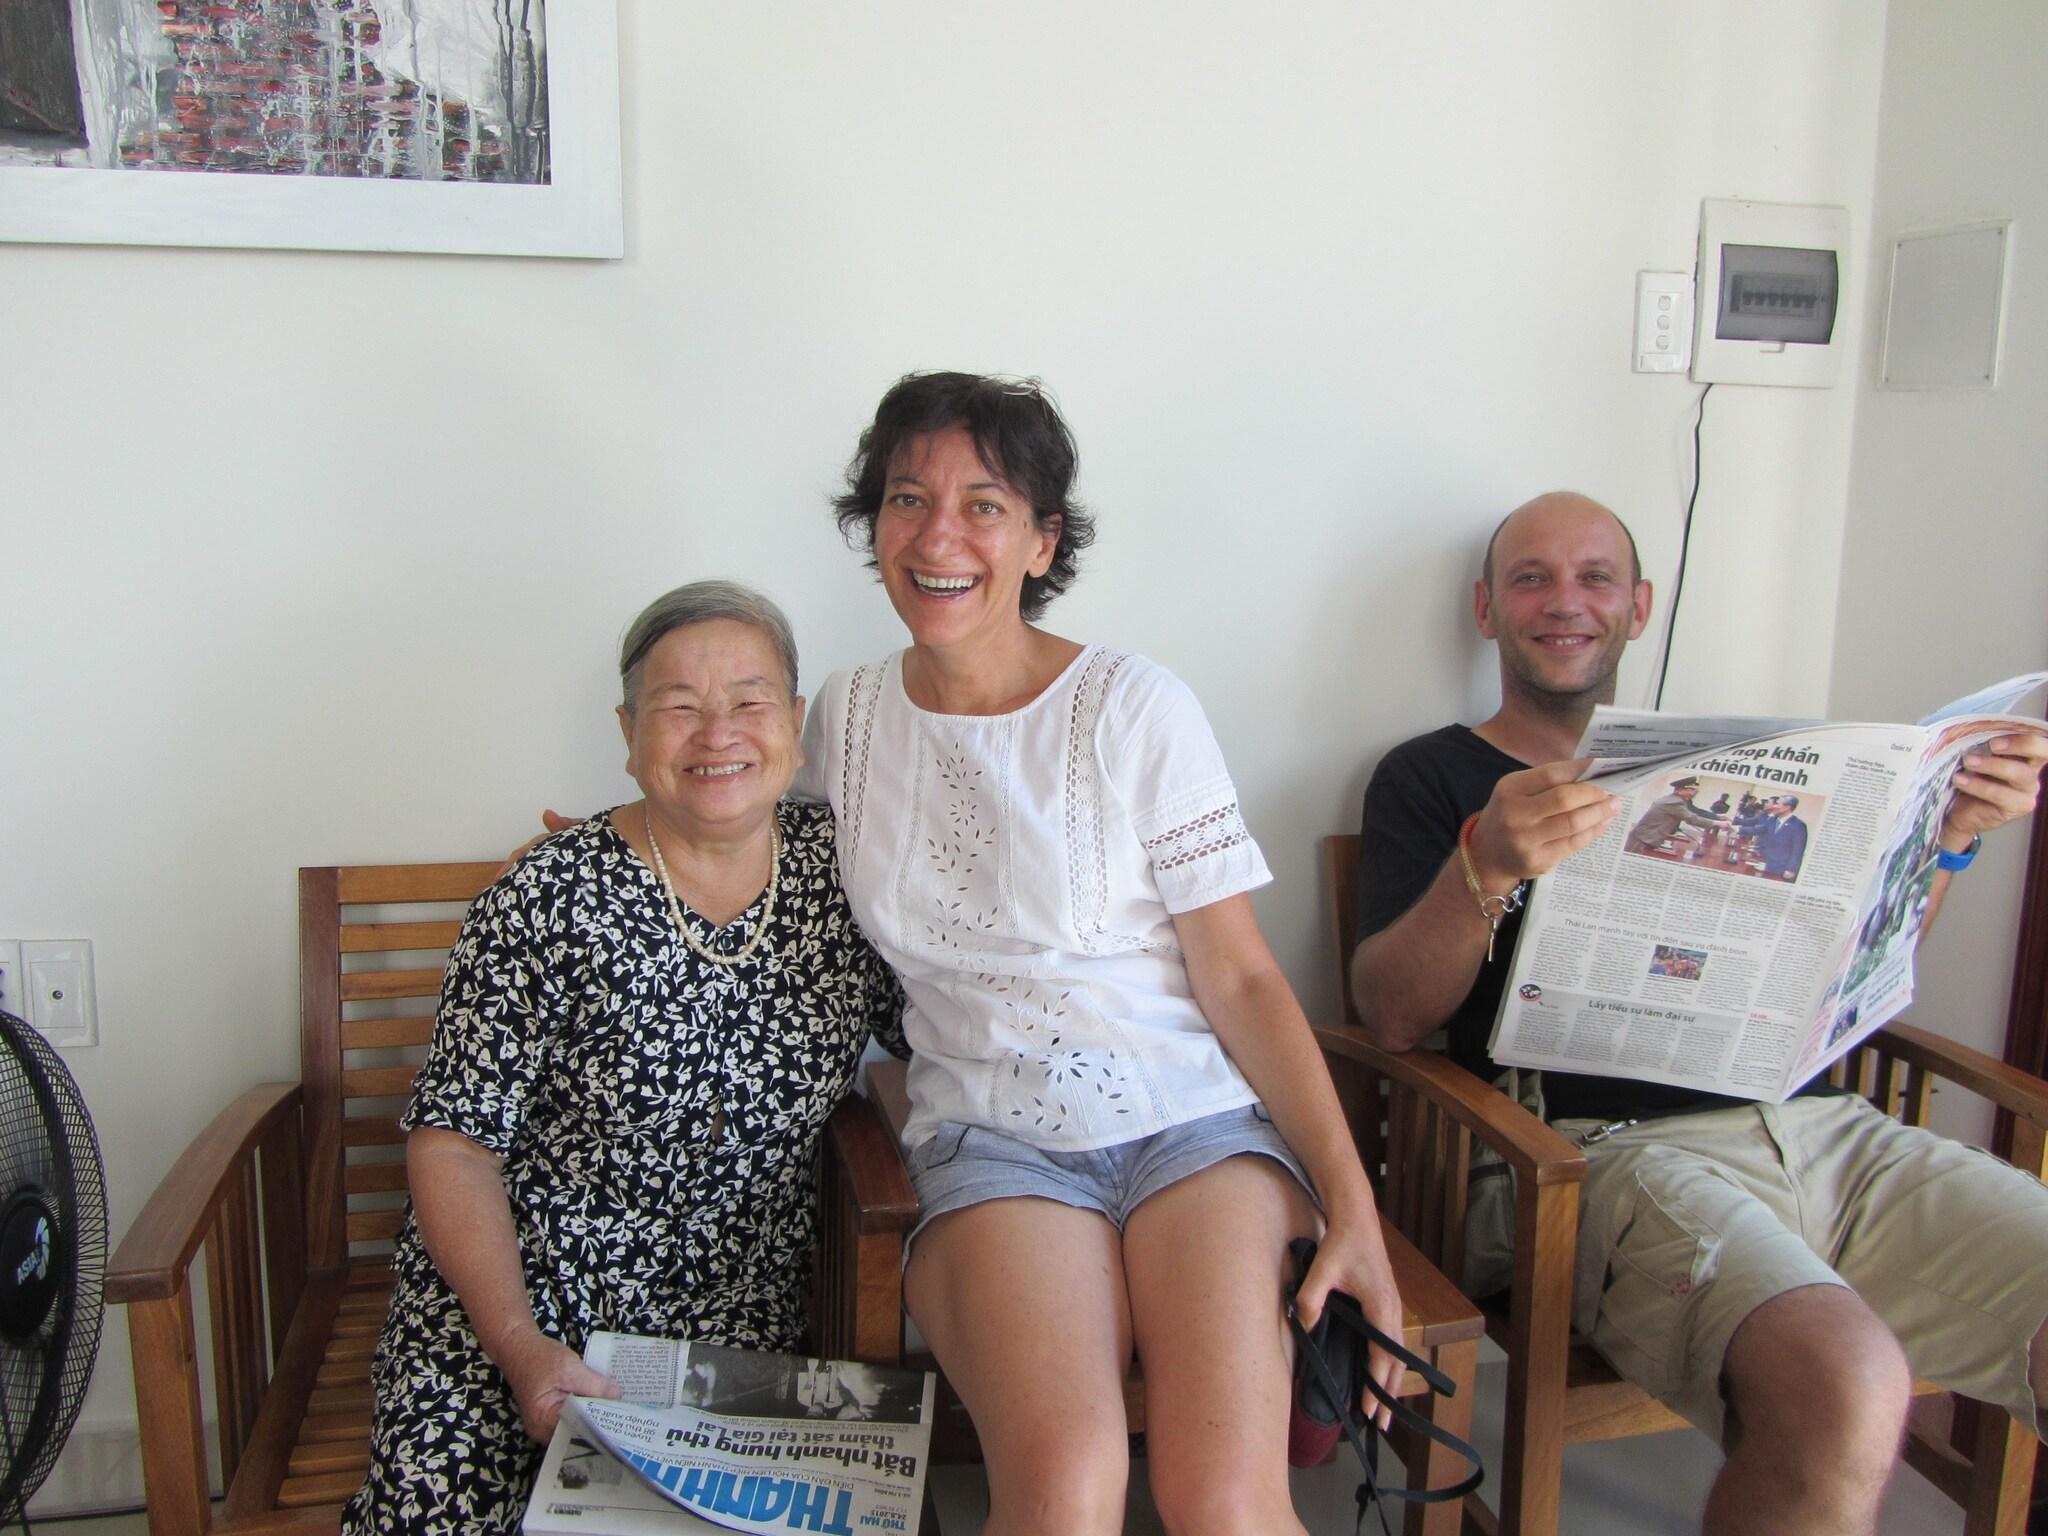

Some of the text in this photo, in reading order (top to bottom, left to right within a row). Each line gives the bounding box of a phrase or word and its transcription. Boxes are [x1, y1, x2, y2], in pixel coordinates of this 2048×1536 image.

[1770, 745, 1820, 765] khẩn
[1700, 757, 1809, 786] chiến tranh
[1582, 921, 1597, 930] Lan
[643, 1426, 656, 1436] 98
[696, 1421, 727, 1438] Lai
[731, 1428, 765, 1443] Gia
[769, 1428, 797, 1443] tại
[804, 1430, 833, 1446] sát
[839, 1433, 895, 1450] thảm
[666, 1428, 917, 1478] Bắt nhanh hung thủ
[679, 1468, 853, 1536] THANH
[860, 1515, 881, 1526] HAI
